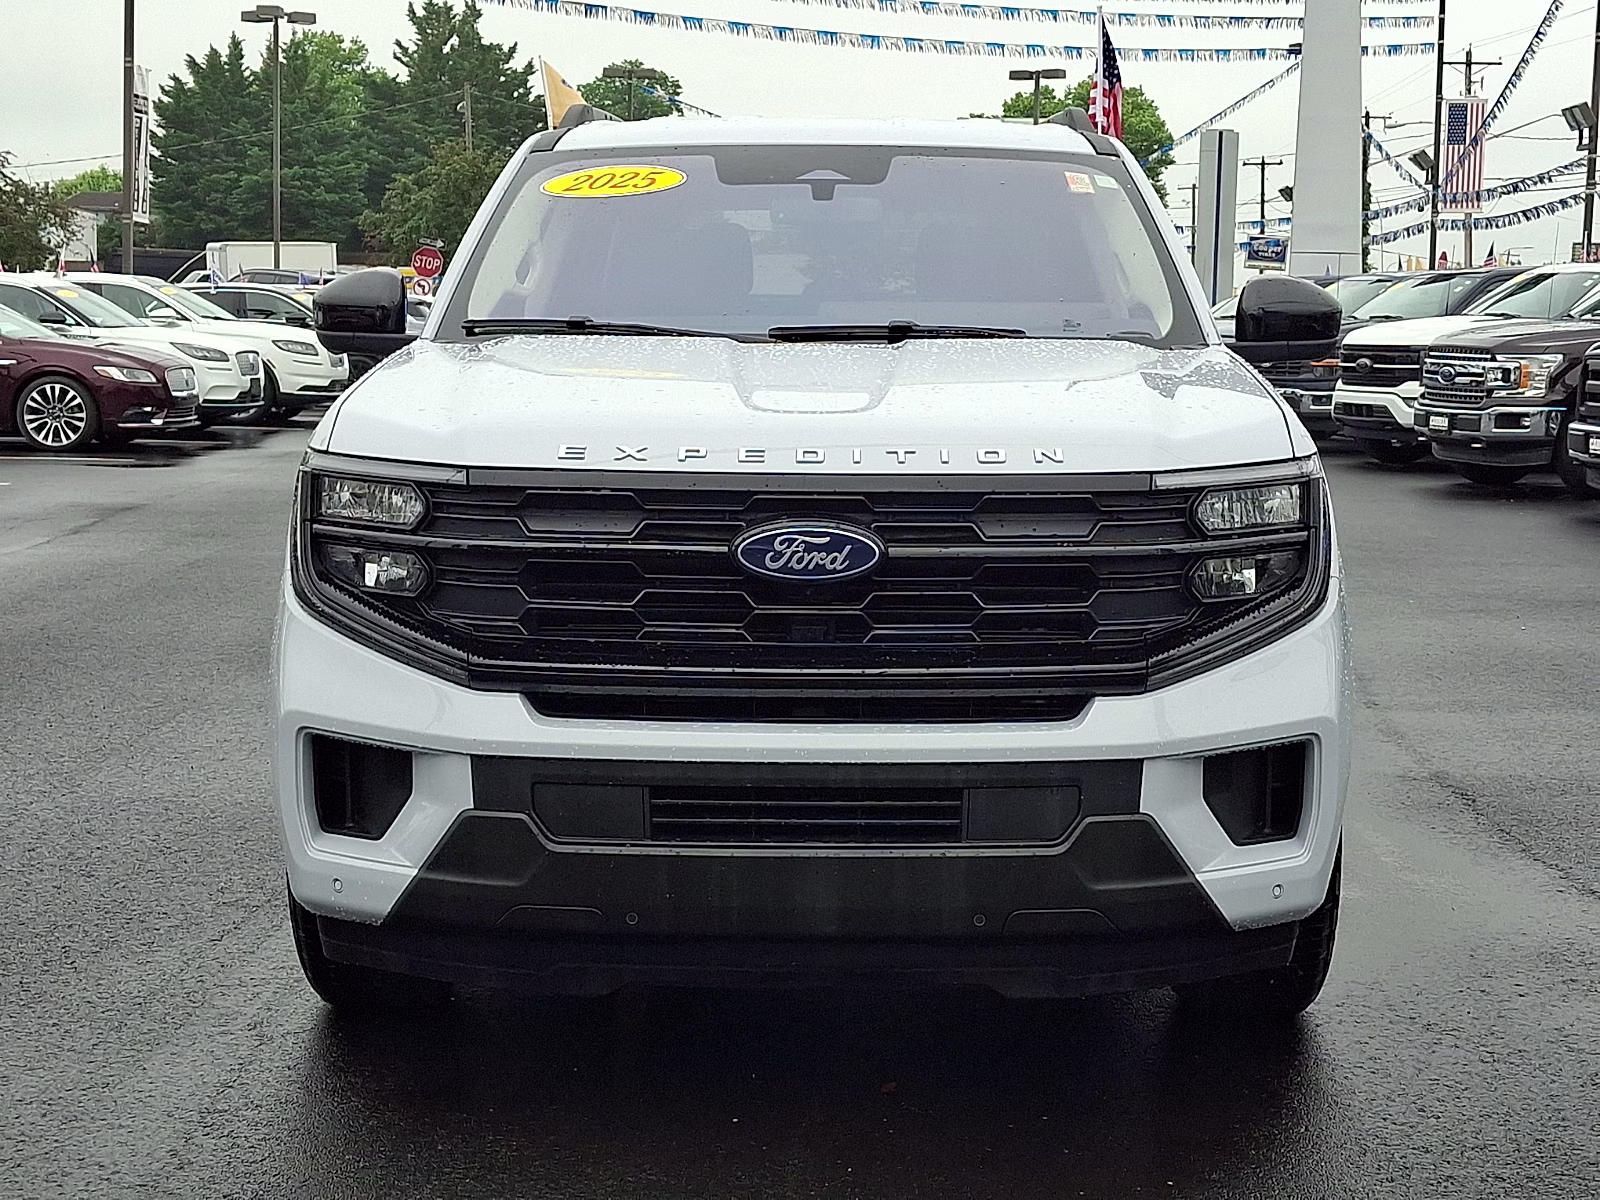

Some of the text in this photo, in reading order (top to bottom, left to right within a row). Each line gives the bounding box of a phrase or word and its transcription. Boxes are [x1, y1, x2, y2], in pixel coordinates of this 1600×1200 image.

[562, 171, 666, 192] 2025
[414, 254, 440, 270] STOP
[557, 444, 1064, 464] EXPEDITION
[765, 534, 852, 570] Ford
